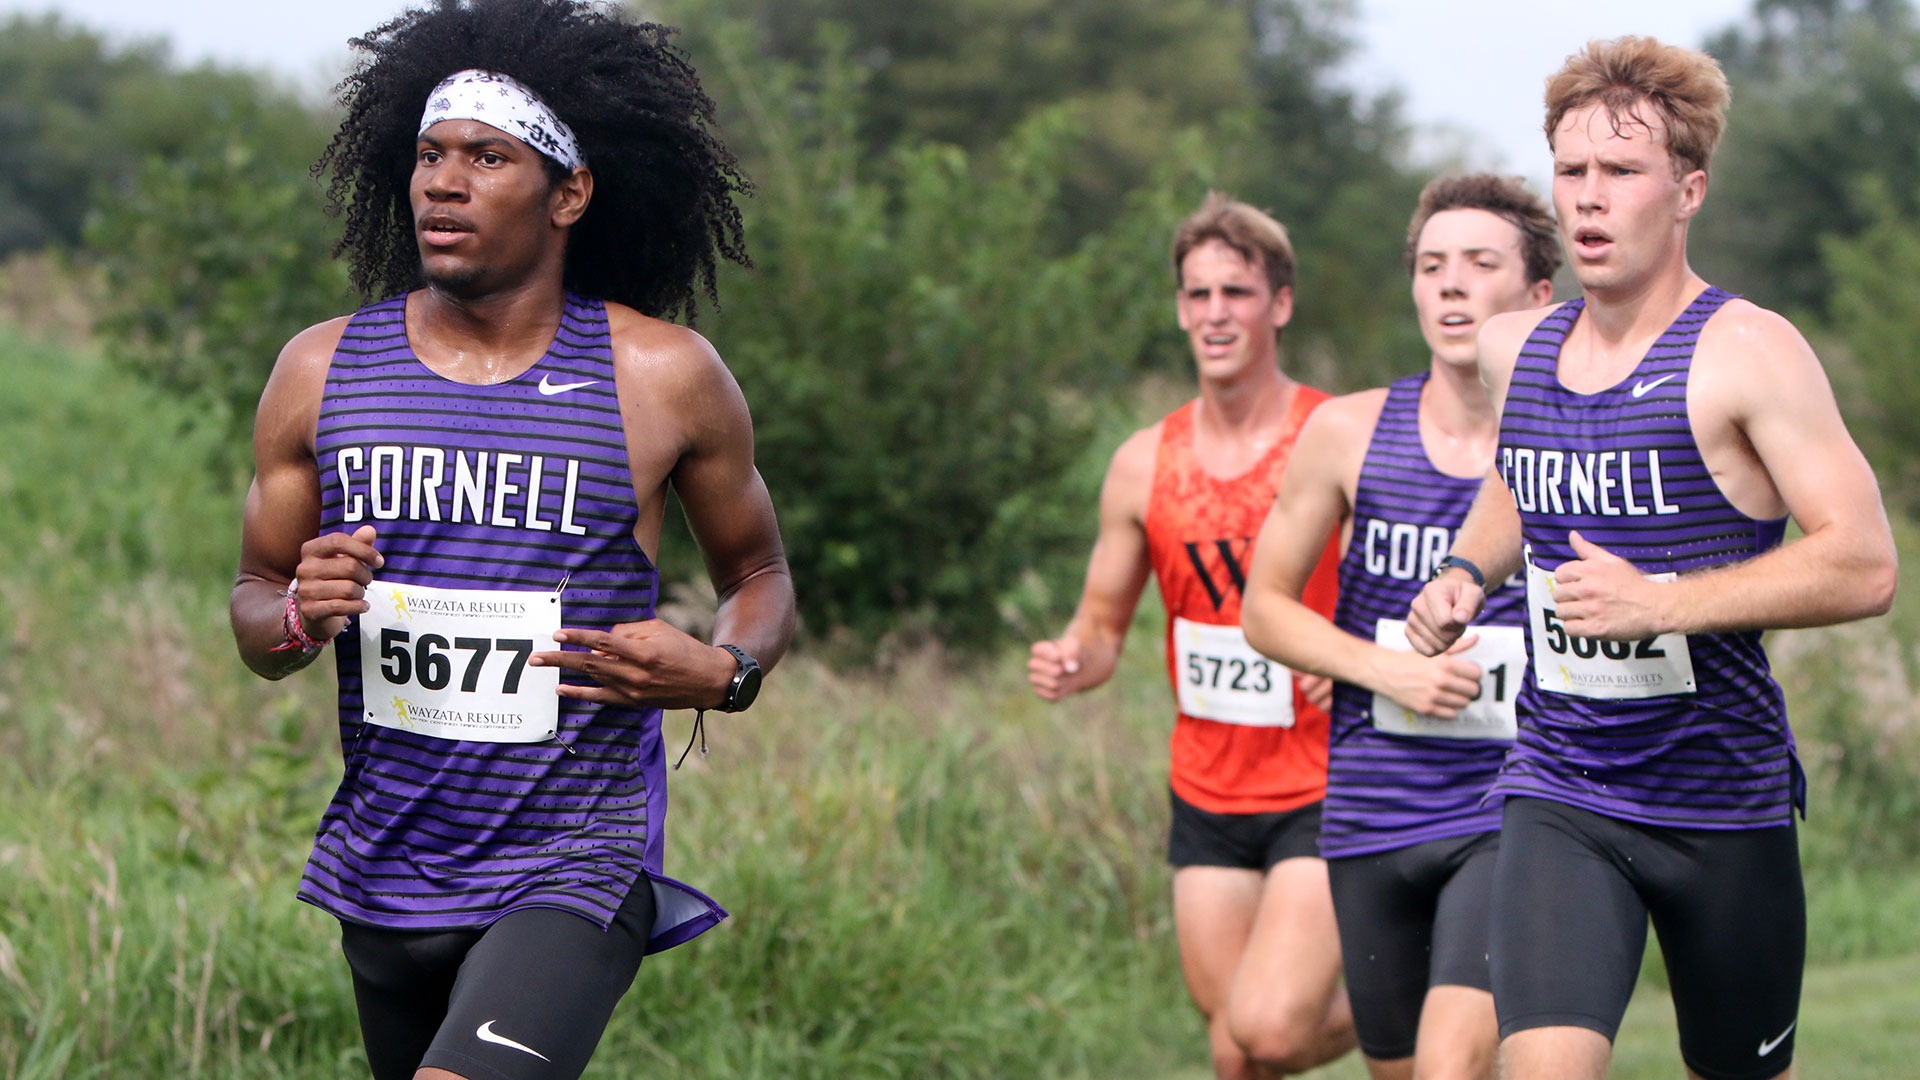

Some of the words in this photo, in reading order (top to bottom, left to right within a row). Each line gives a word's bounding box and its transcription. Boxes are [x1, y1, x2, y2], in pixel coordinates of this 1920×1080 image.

[336, 446, 587, 536] CORNELL
[1502, 447, 1680, 516] CORNELL
[407, 596, 465, 612] WAYZATA
[470, 601, 526, 614] RESULTS
[380, 627, 534, 695] 5677
[1187, 652, 1272, 693] 5723
[1570, 671, 1614, 684] WAYZATA
[1617, 671, 1664, 684] RESULTS
[408, 704, 463, 722] WAYZATA
[467, 712, 523, 725] RESULTS
